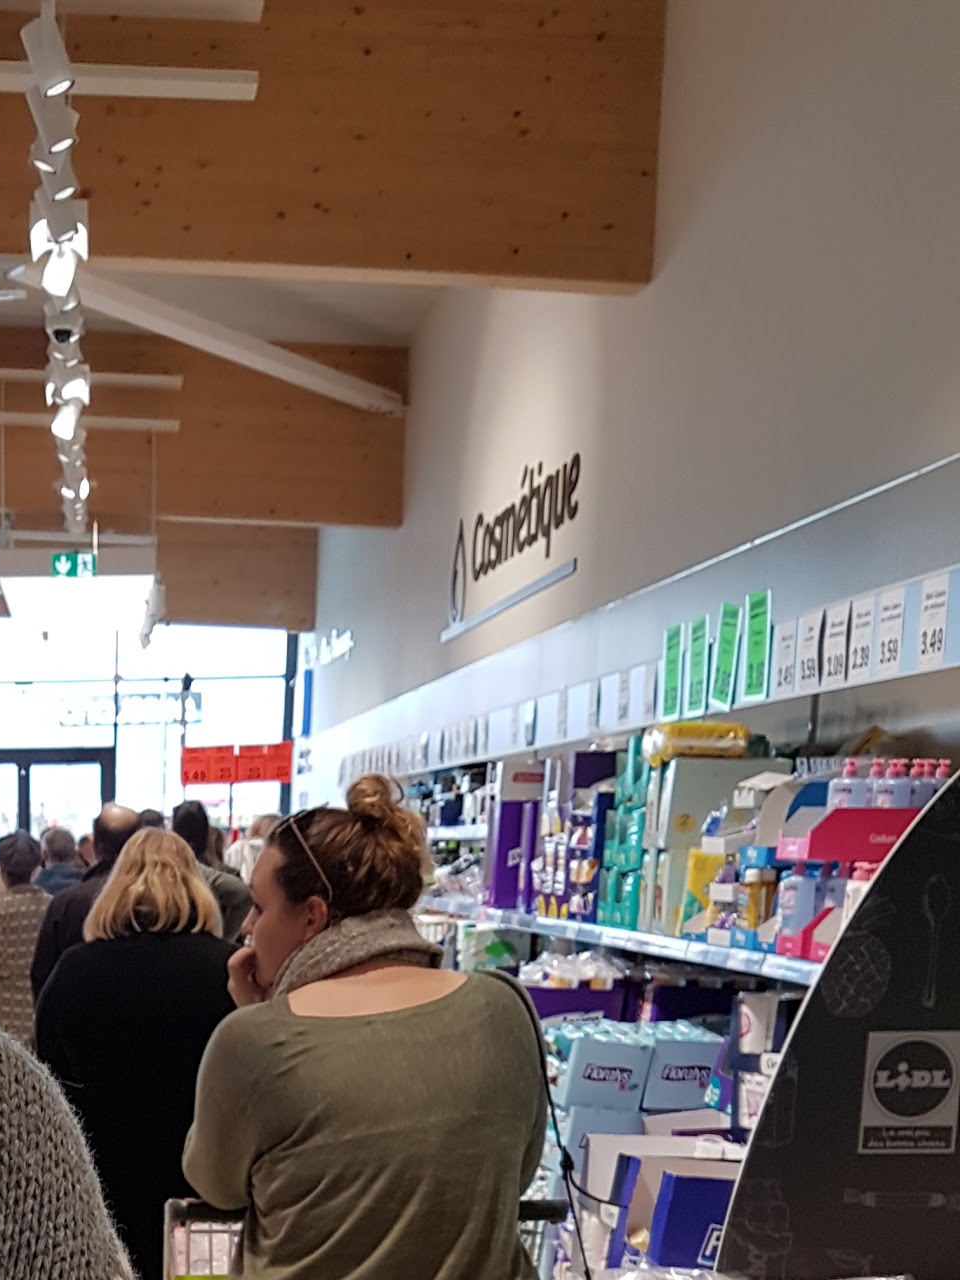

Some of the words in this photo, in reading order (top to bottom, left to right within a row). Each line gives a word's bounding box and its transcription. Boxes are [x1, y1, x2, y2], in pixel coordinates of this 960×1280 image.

[472, 452, 580, 581] Cosmétique
[879, 637, 899, 665] 3.59
[921, 627, 944, 655] 3.49
